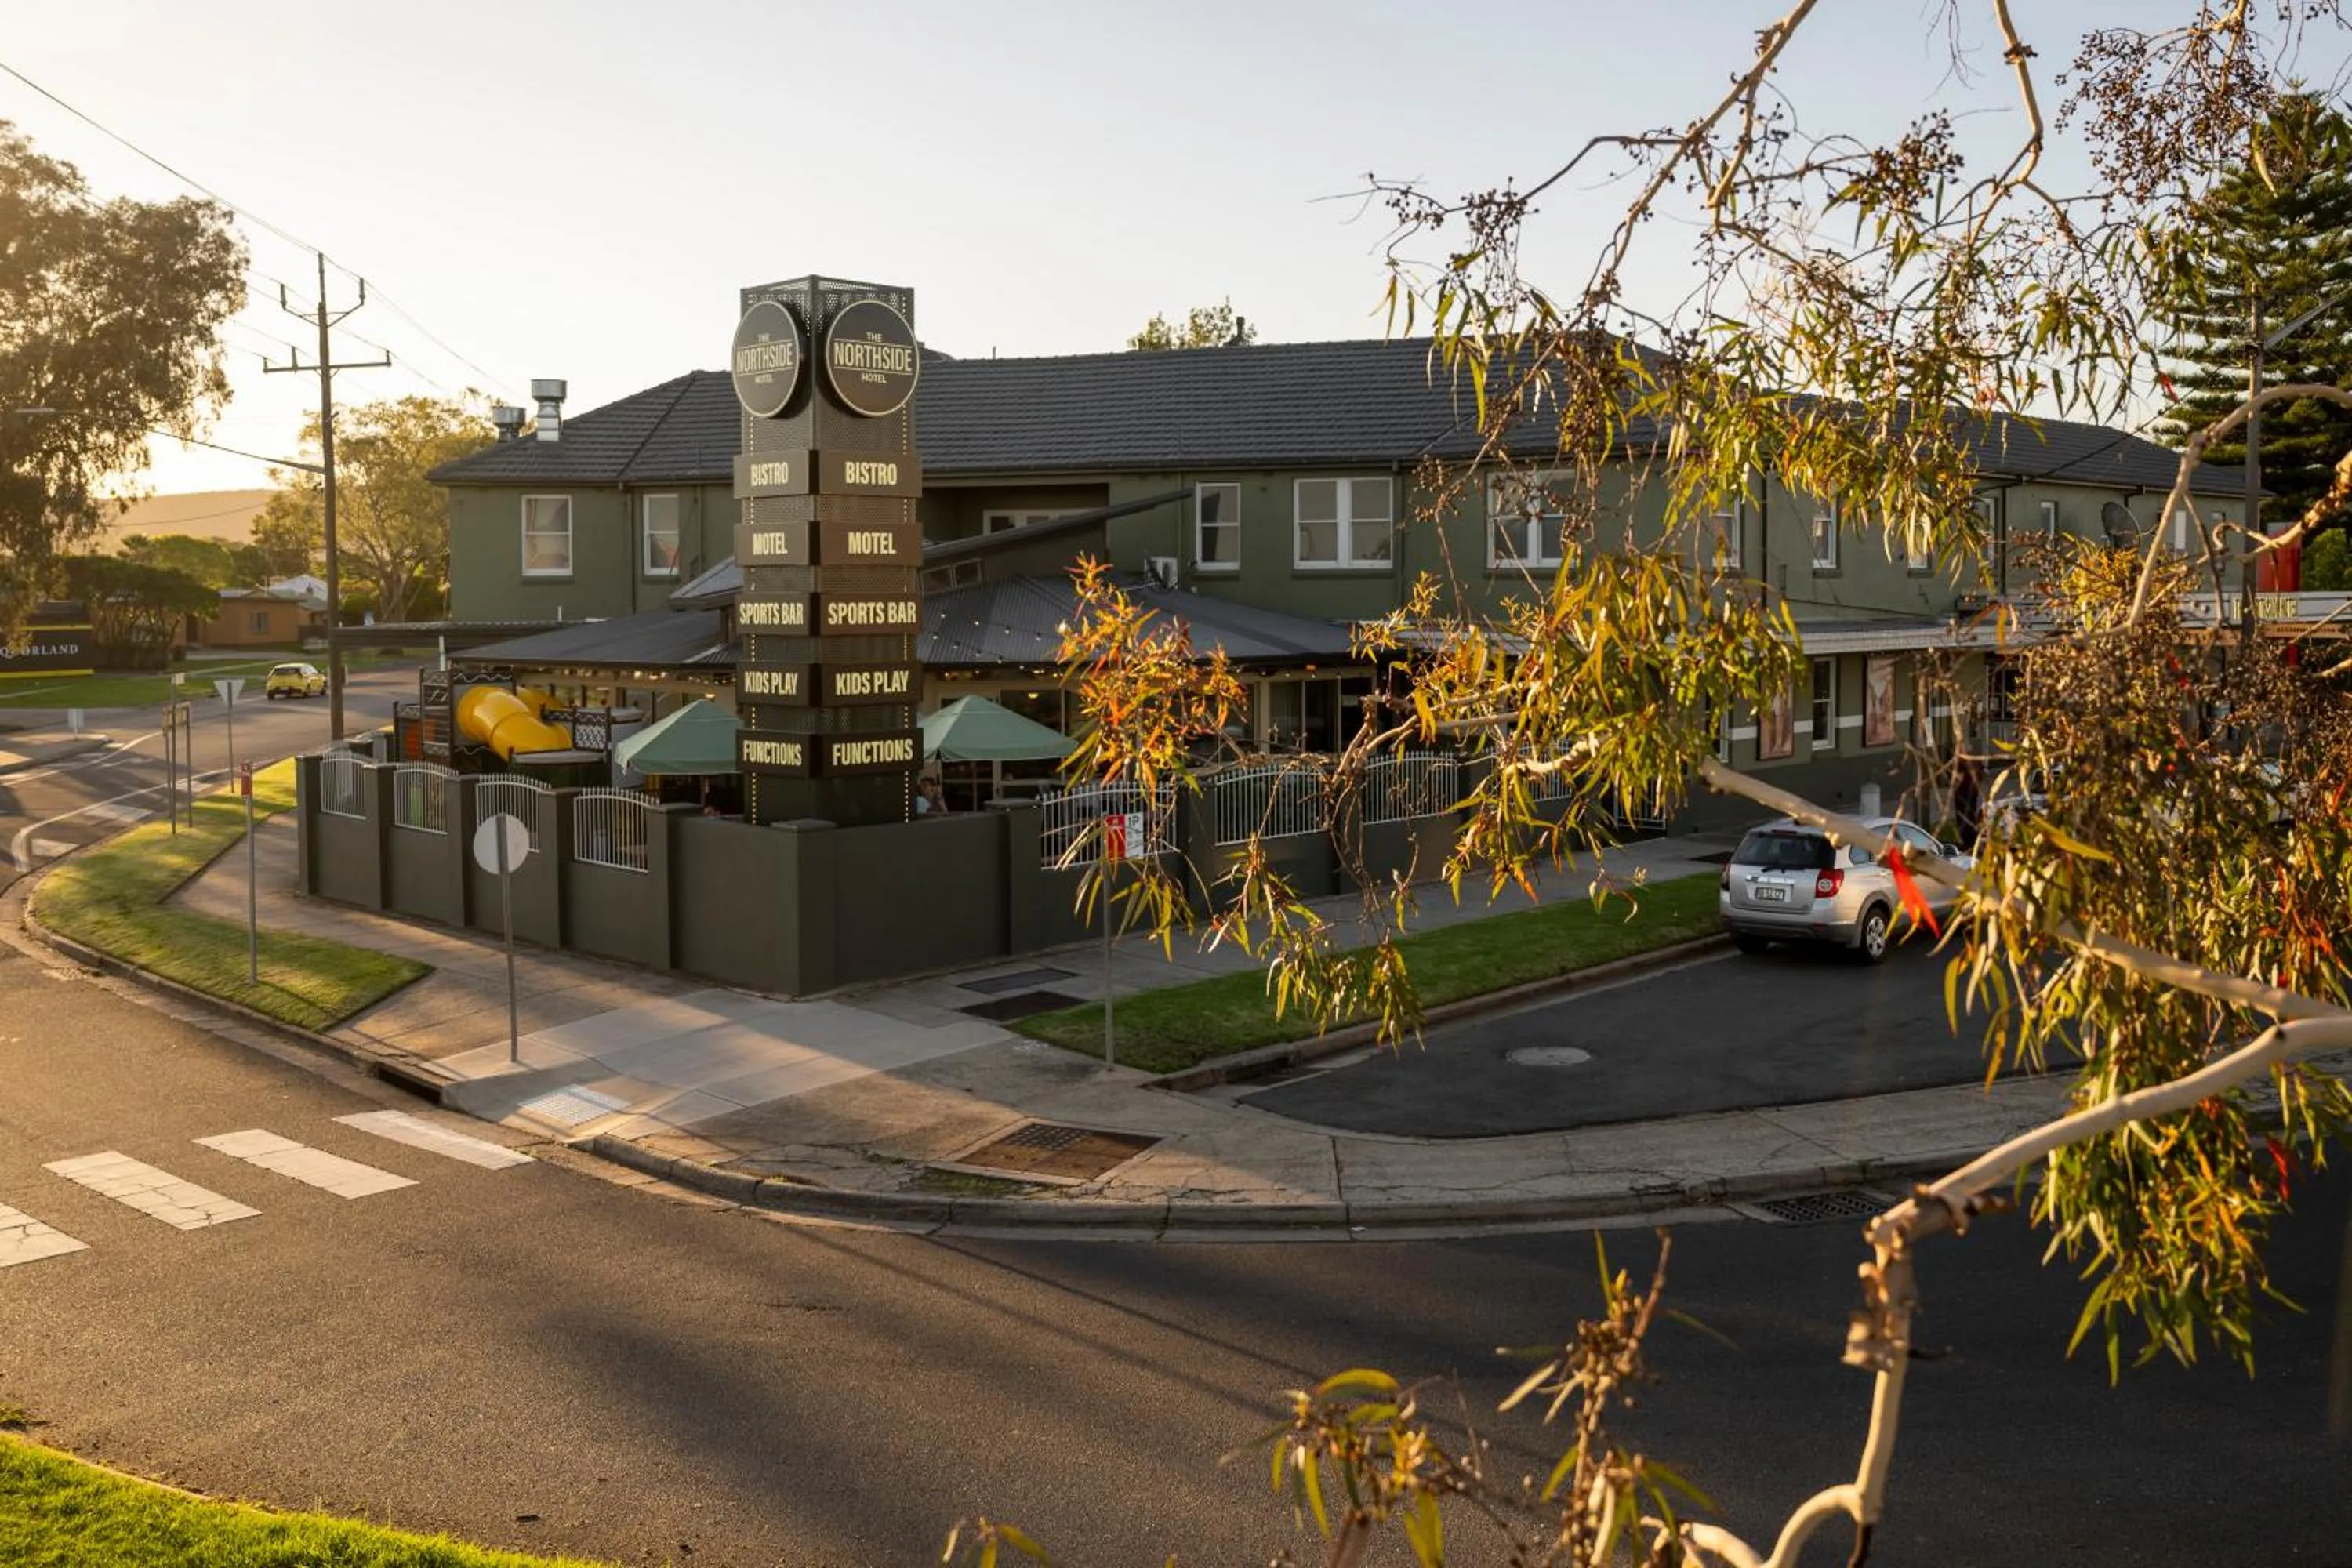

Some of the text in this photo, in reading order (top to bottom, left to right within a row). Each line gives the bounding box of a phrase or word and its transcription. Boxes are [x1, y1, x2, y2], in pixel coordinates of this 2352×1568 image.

[866, 332, 883, 343] THE
[737, 343, 793, 372] NORTHSIDE
[833, 343, 913, 372] NORTHSIDE
[862, 374, 888, 383] HOTEL
[750, 463, 789, 486] BISTRO
[845, 461, 897, 485] BISTRO
[753, 532, 788, 555] MOTEL
[848, 532, 896, 554] MOTEL
[739, 602, 804, 625] SPORTS BAR
[828, 601, 916, 625] SPORTS BAR
[745, 671, 798, 695] KIDS PLAY
[835, 670, 909, 695] KIDS PLAY
[743, 739, 802, 766] FUNCTIONS
[833, 739, 913, 766] FUNCTIONS
